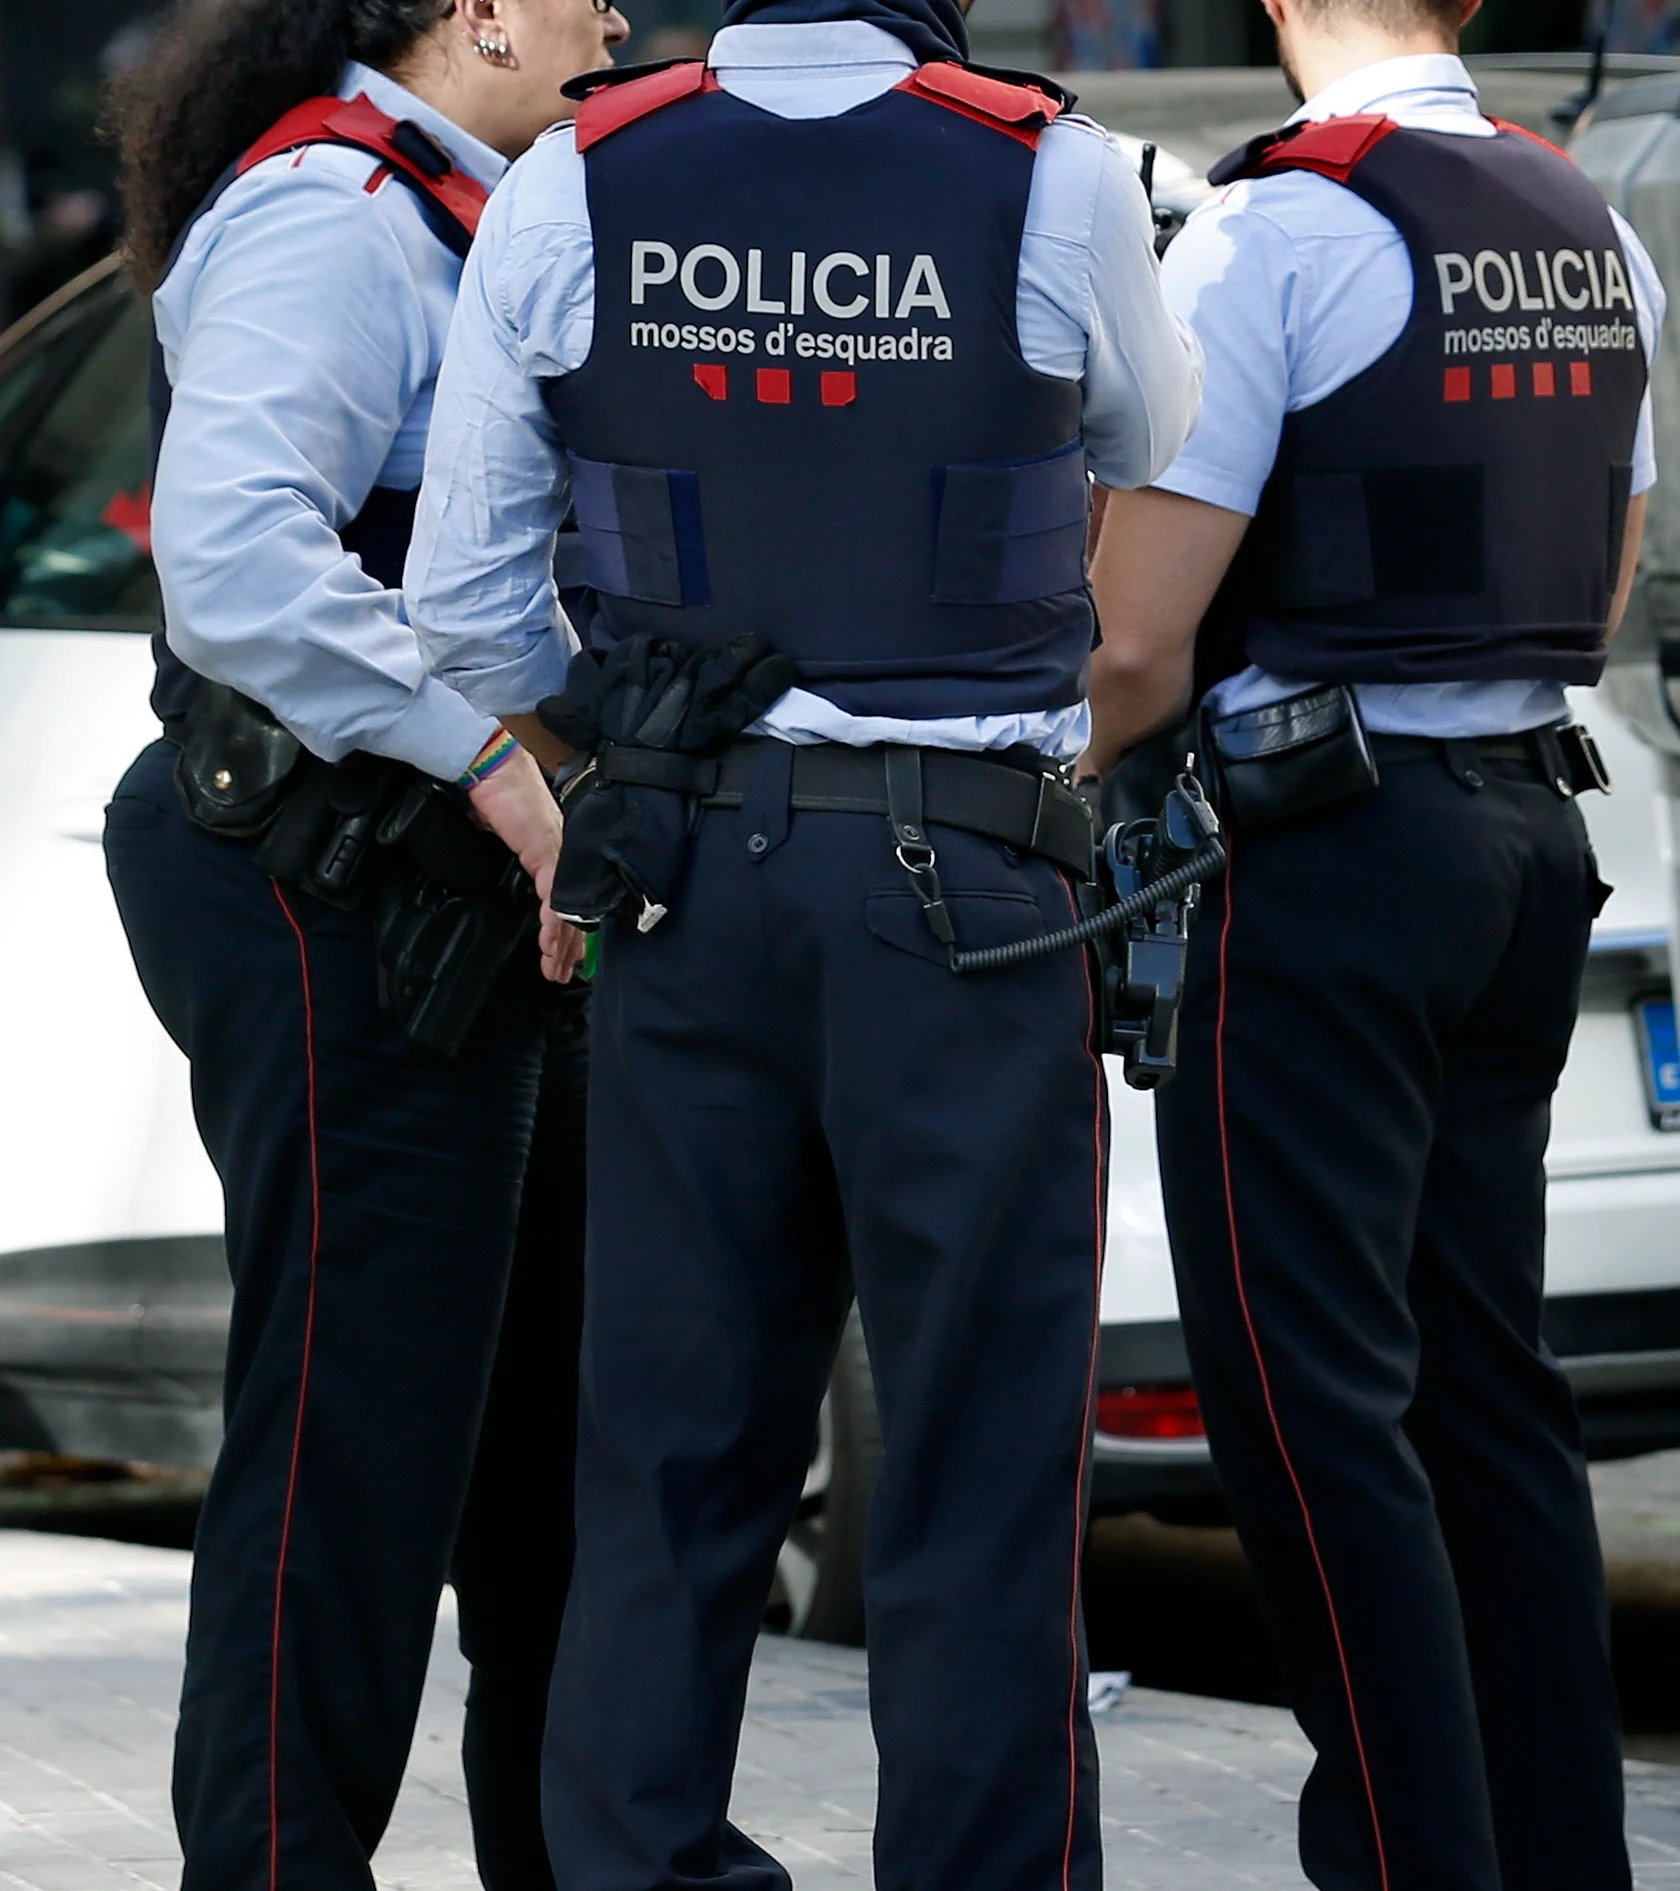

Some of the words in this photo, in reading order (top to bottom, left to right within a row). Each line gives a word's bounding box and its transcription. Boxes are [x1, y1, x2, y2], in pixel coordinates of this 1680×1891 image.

[630, 240, 951, 319] POLICIA
[1434, 248, 1634, 315] POLICIA
[630, 321, 755, 354] mossos
[1443, 326, 1531, 355] mossos
